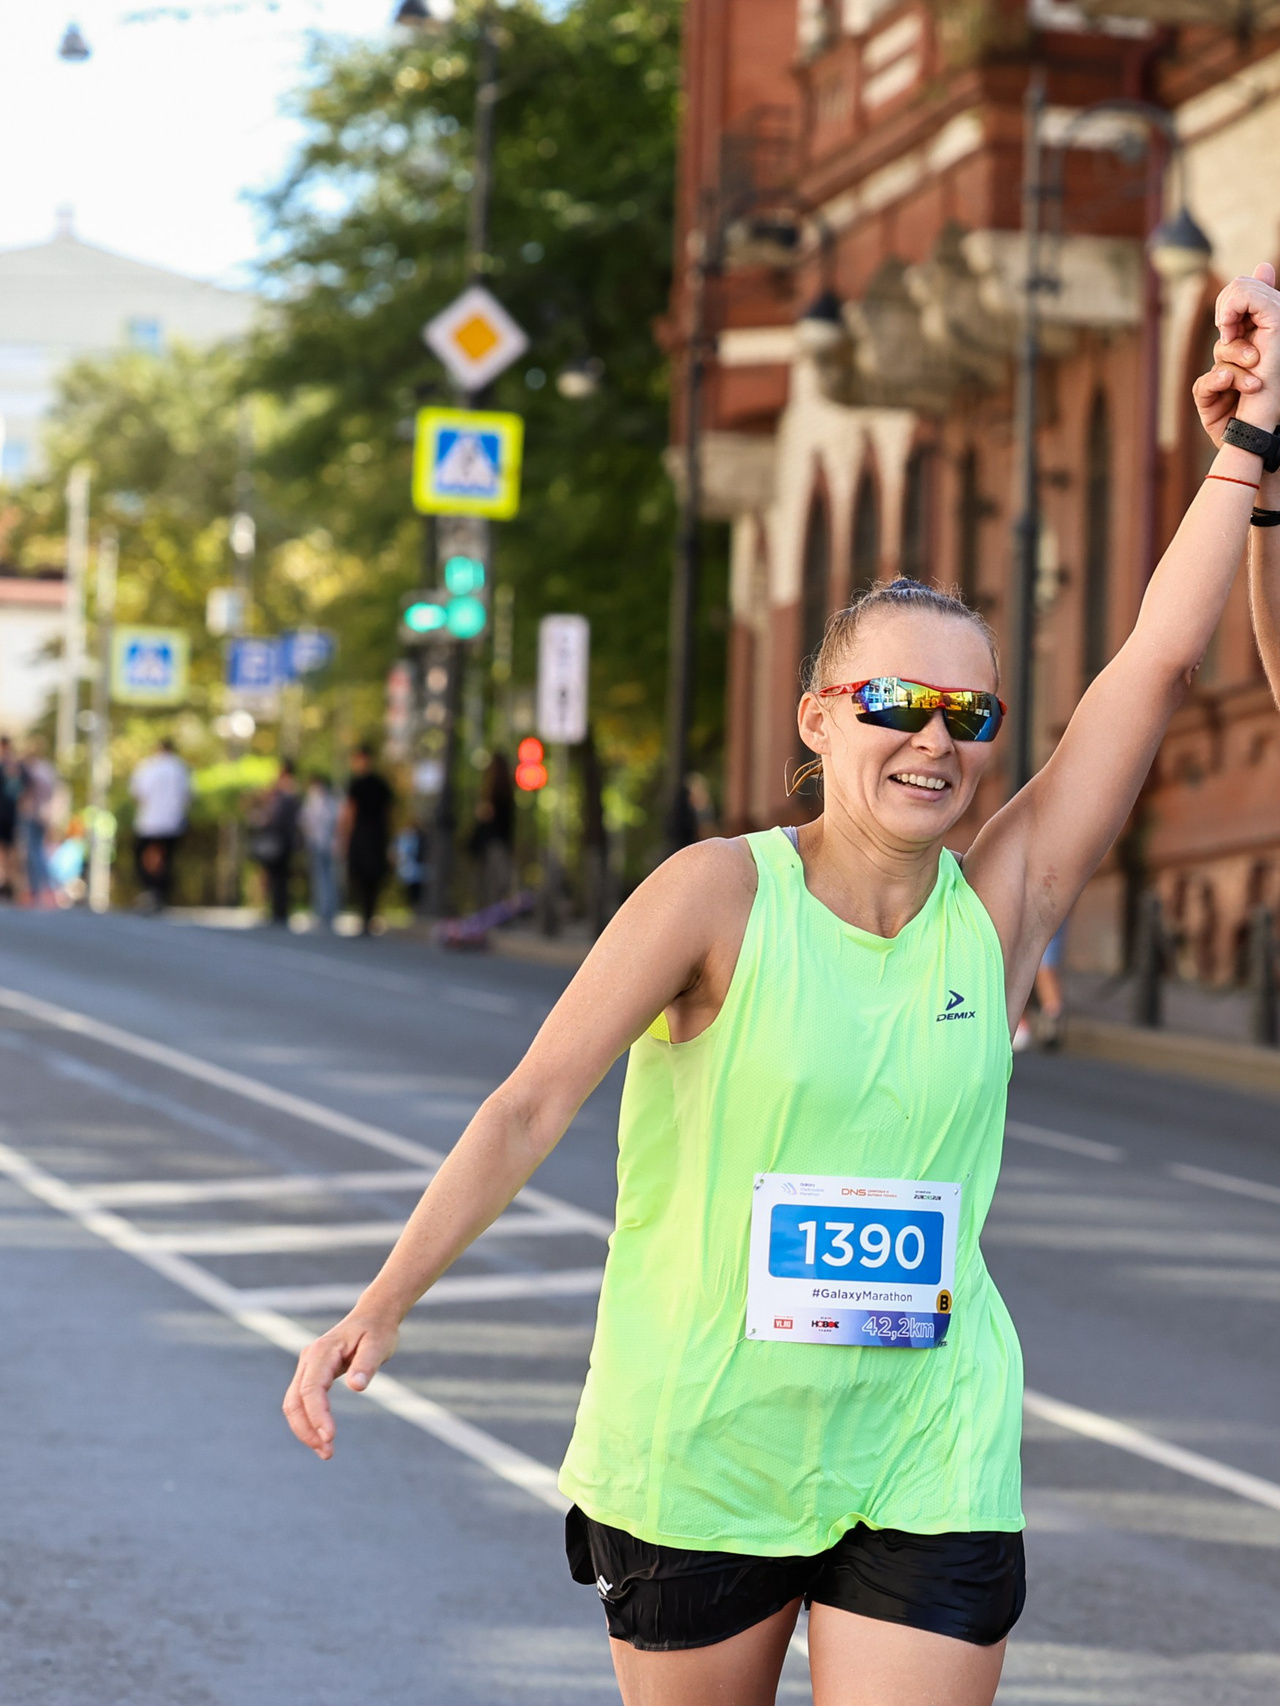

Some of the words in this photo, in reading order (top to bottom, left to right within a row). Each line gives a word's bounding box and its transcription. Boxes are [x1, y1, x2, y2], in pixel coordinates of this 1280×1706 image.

[936, 1011, 976, 1022] DEMIX
[841, 1188, 867, 1197] DNS
[798, 1220, 925, 1270] 1390
[812, 1288, 913, 1303] #GalaxyMarathon
[939, 1294, 949, 1311] B
[862, 1316, 935, 1340] 42,2km
